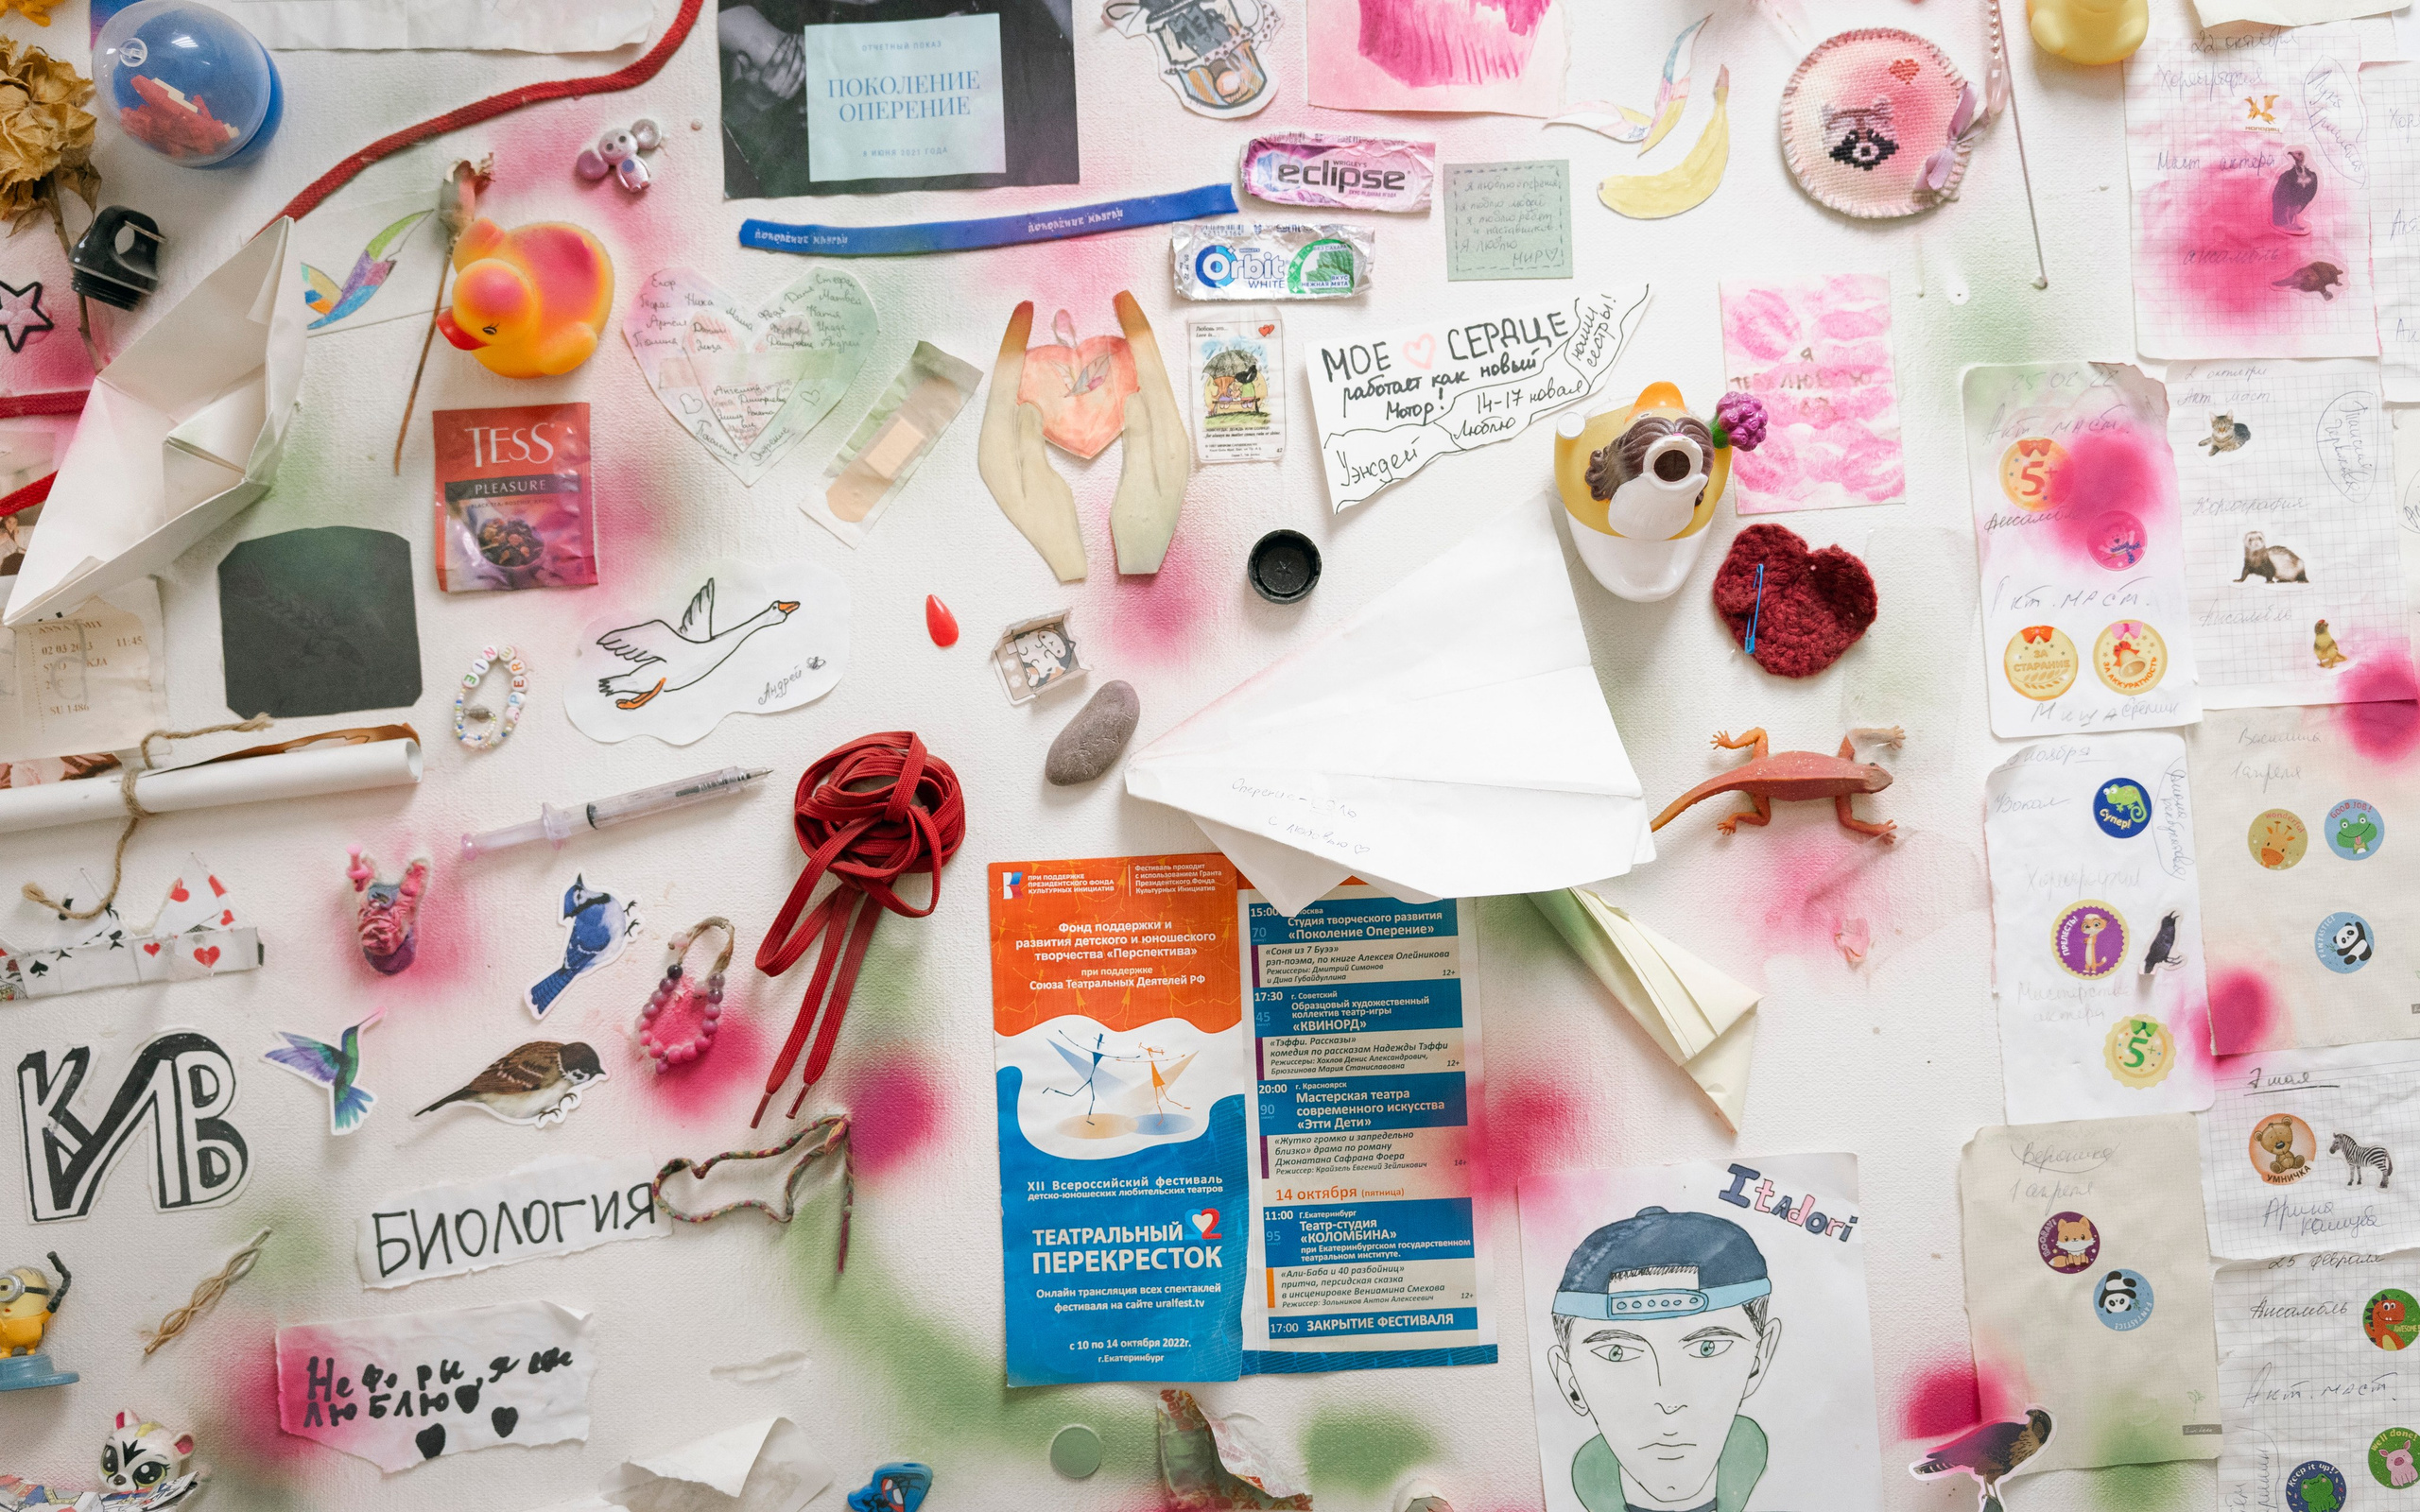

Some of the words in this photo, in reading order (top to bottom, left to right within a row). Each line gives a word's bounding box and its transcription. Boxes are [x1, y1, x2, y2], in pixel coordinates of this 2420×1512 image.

[861, 43, 911, 52] ОТЧЕТНЫЙ
[913, 41, 942, 50] ПОКАЗ
[828, 70, 980, 98] ПОКОЛЕНИЕ
[838, 96, 971, 123] ОПЕРЕНИЕ
[871, 148, 898, 157] ИЮНЯ
[925, 146, 948, 156] ГОДА
[1333, 160, 1367, 168] WRIGLEY'S
[1278, 160, 1406, 194] eclipse
[1197, 246, 1285, 284] Orbit
[1248, 280, 1285, 289] WHITE
[1322, 341, 1392, 382] МОЕ
[1447, 311, 1569, 361] СЕРДЦЕ
[1343, 375, 1423, 419] работает
[1431, 370, 1470, 387] как
[1479, 346, 1541, 378] новый
[1477, 388, 1523, 414] 14-17
[464, 422, 554, 468] TESS
[475, 479, 546, 495] PLEASURE
[2033, 649, 2048, 659] ЗА
[2014, 660, 2070, 672] СТАРАНИЕ
[2108, 657, 2157, 689] АККУРАТНОСТЬ
[2330, 802, 2351, 819] GOOD
[2100, 809, 2132, 830] Супер!
[2265, 812, 2305, 833] wonderful
[1173, 864, 1204, 872] проходит
[1028, 880, 1087, 888] ПРЕЗИДЕНТСКОГО
[1089, 879, 1114, 887] ФОНДА
[1043, 873, 1083, 882] ПОДДЕРЖКЕ
[1135, 885, 1175, 894] Культурных
[1059, 922, 1091, 933] Фонд
[1095, 921, 1161, 932] поддержки
[1288, 917, 1323, 927] Студия
[1326, 915, 1391, 925] творческого
[1394, 912, 1442, 922] развития
[1288, 929, 1362, 938] «Поколение
[1366, 925, 1433, 936] Оперение»
[2061, 916, 2079, 956] ПРЕЛЕСТЬ!
[2319, 915, 2336, 960] FANTASTIC!
[1016, 938, 1071, 950] развития
[1074, 936, 1127, 947] детского
[1142, 933, 1215, 943] юношеского
[1034, 951, 1102, 961] творчества
[1107, 948, 1197, 959] «Перспектива»
[1100, 967, 1152, 975] поддержке
[1029, 981, 1063, 989] Союза
[1065, 979, 1133, 988] Театральных
[1136, 974, 1186, 988] Деятелей
[1190, 974, 1204, 984] РФ
[1254, 992, 1284, 1003] 17:30
[1291, 999, 1349, 1011] Образцовый
[1352, 996, 1429, 1007] художественный
[1293, 1019, 1366, 1030] «КВИНОРД»
[2267, 1165, 2311, 1183] УМНИЧКА
[1028, 1181, 1044, 1191] XII
[1052, 1177, 1148, 1190] Всероссийский
[1155, 1176, 1222, 1187] фестиваль
[1028, 1190, 1115, 1201] детско-юношеских
[1118, 1187, 1184, 1195] любительских
[1276, 1189, 1292, 1200] 14
[1297, 1186, 1356, 1200] октября
[1361, 1188, 1404, 1197] (пятница)
[1265, 1211, 1294, 1221] 11:00
[372, 1182, 655, 1278] БИОЛОГИЯ
[1032, 1221, 1183, 1246] ТЕАТРАЛЬНЫЙ
[1300, 1220, 1376, 1232] Театр-студия
[1301, 1229, 1396, 1243] «КОЛОМБИНА»
[1032, 1246, 1221, 1273] ПЕРЕКРЕСТОК
[1036, 1287, 1075, 1297] Онлайн
[1078, 1287, 1136, 1297] трансляция
[1164, 1282, 1220, 1293] спектаклей
[1054, 1302, 1107, 1313] фестиваля
[1125, 1299, 1152, 1308] сайте
[1155, 1297, 1204, 1307] uralfest.tv
[1270, 1323, 1299, 1333] 17:00
[1306, 1317, 1374, 1331] ЗАКРЫТИЕ
[1377, 1314, 1453, 1327] ФЕСТИВАЛЯ
[2115, 1301, 2152, 1332] FANTASTIC!
[1077, 1340, 1088, 1349] 10
[1106, 1339, 1117, 1348] 14
[1120, 1339, 1159, 1349] октября
[1163, 1338, 1191, 1349] 2022г.
[1098, 1353, 1164, 1363] г.Екатеринбург
[2371, 1434, 2388, 1452] well
[2390, 1429, 2418, 1442] done!
[2288, 1467, 2307, 1487] keep
[2308, 1463, 2316, 1471] it
